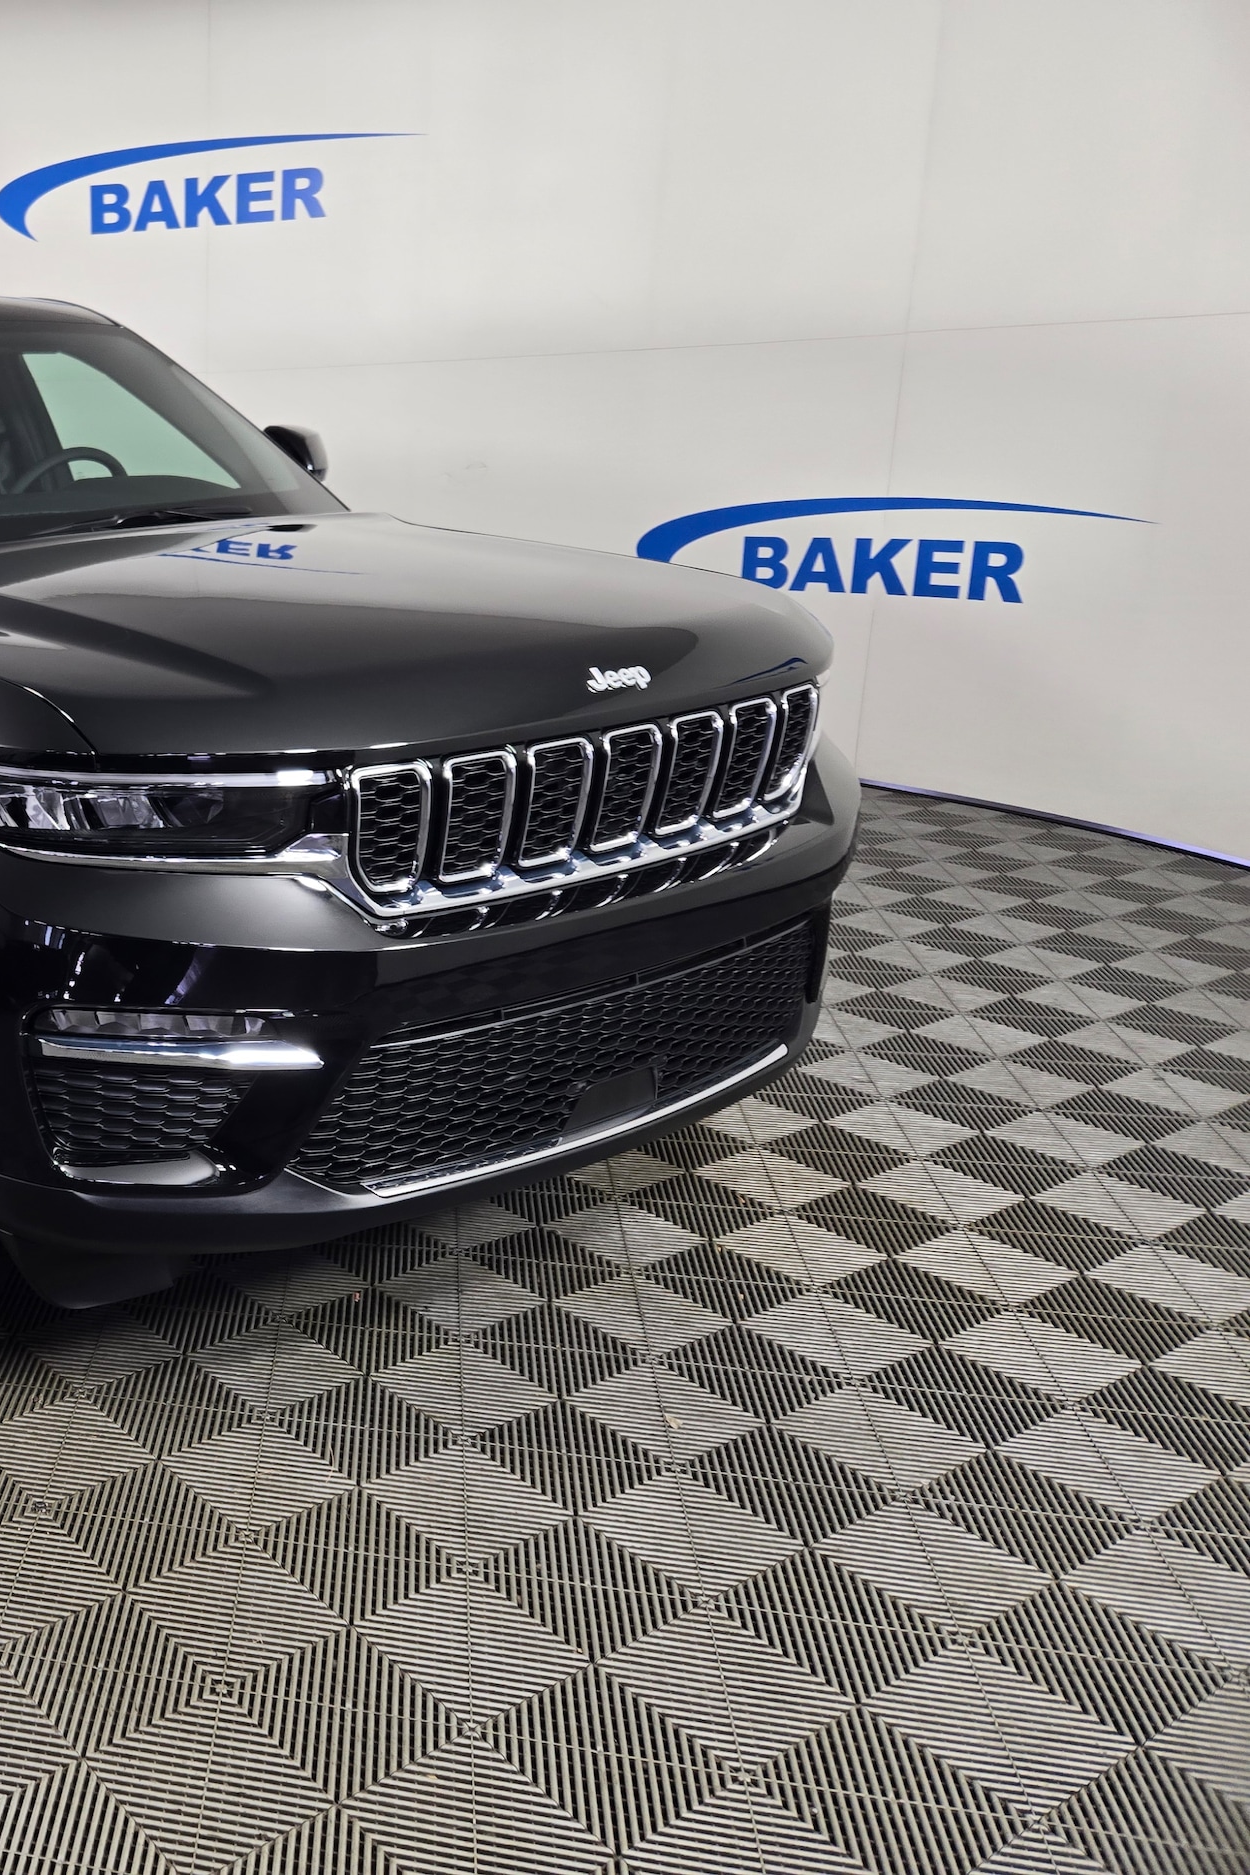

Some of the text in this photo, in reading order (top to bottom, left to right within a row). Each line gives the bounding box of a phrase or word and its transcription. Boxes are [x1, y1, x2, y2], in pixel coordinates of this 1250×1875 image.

[89, 167, 326, 235] BAKER
[741, 536, 1025, 604] BAKER
[586, 665, 652, 692] Jeep
